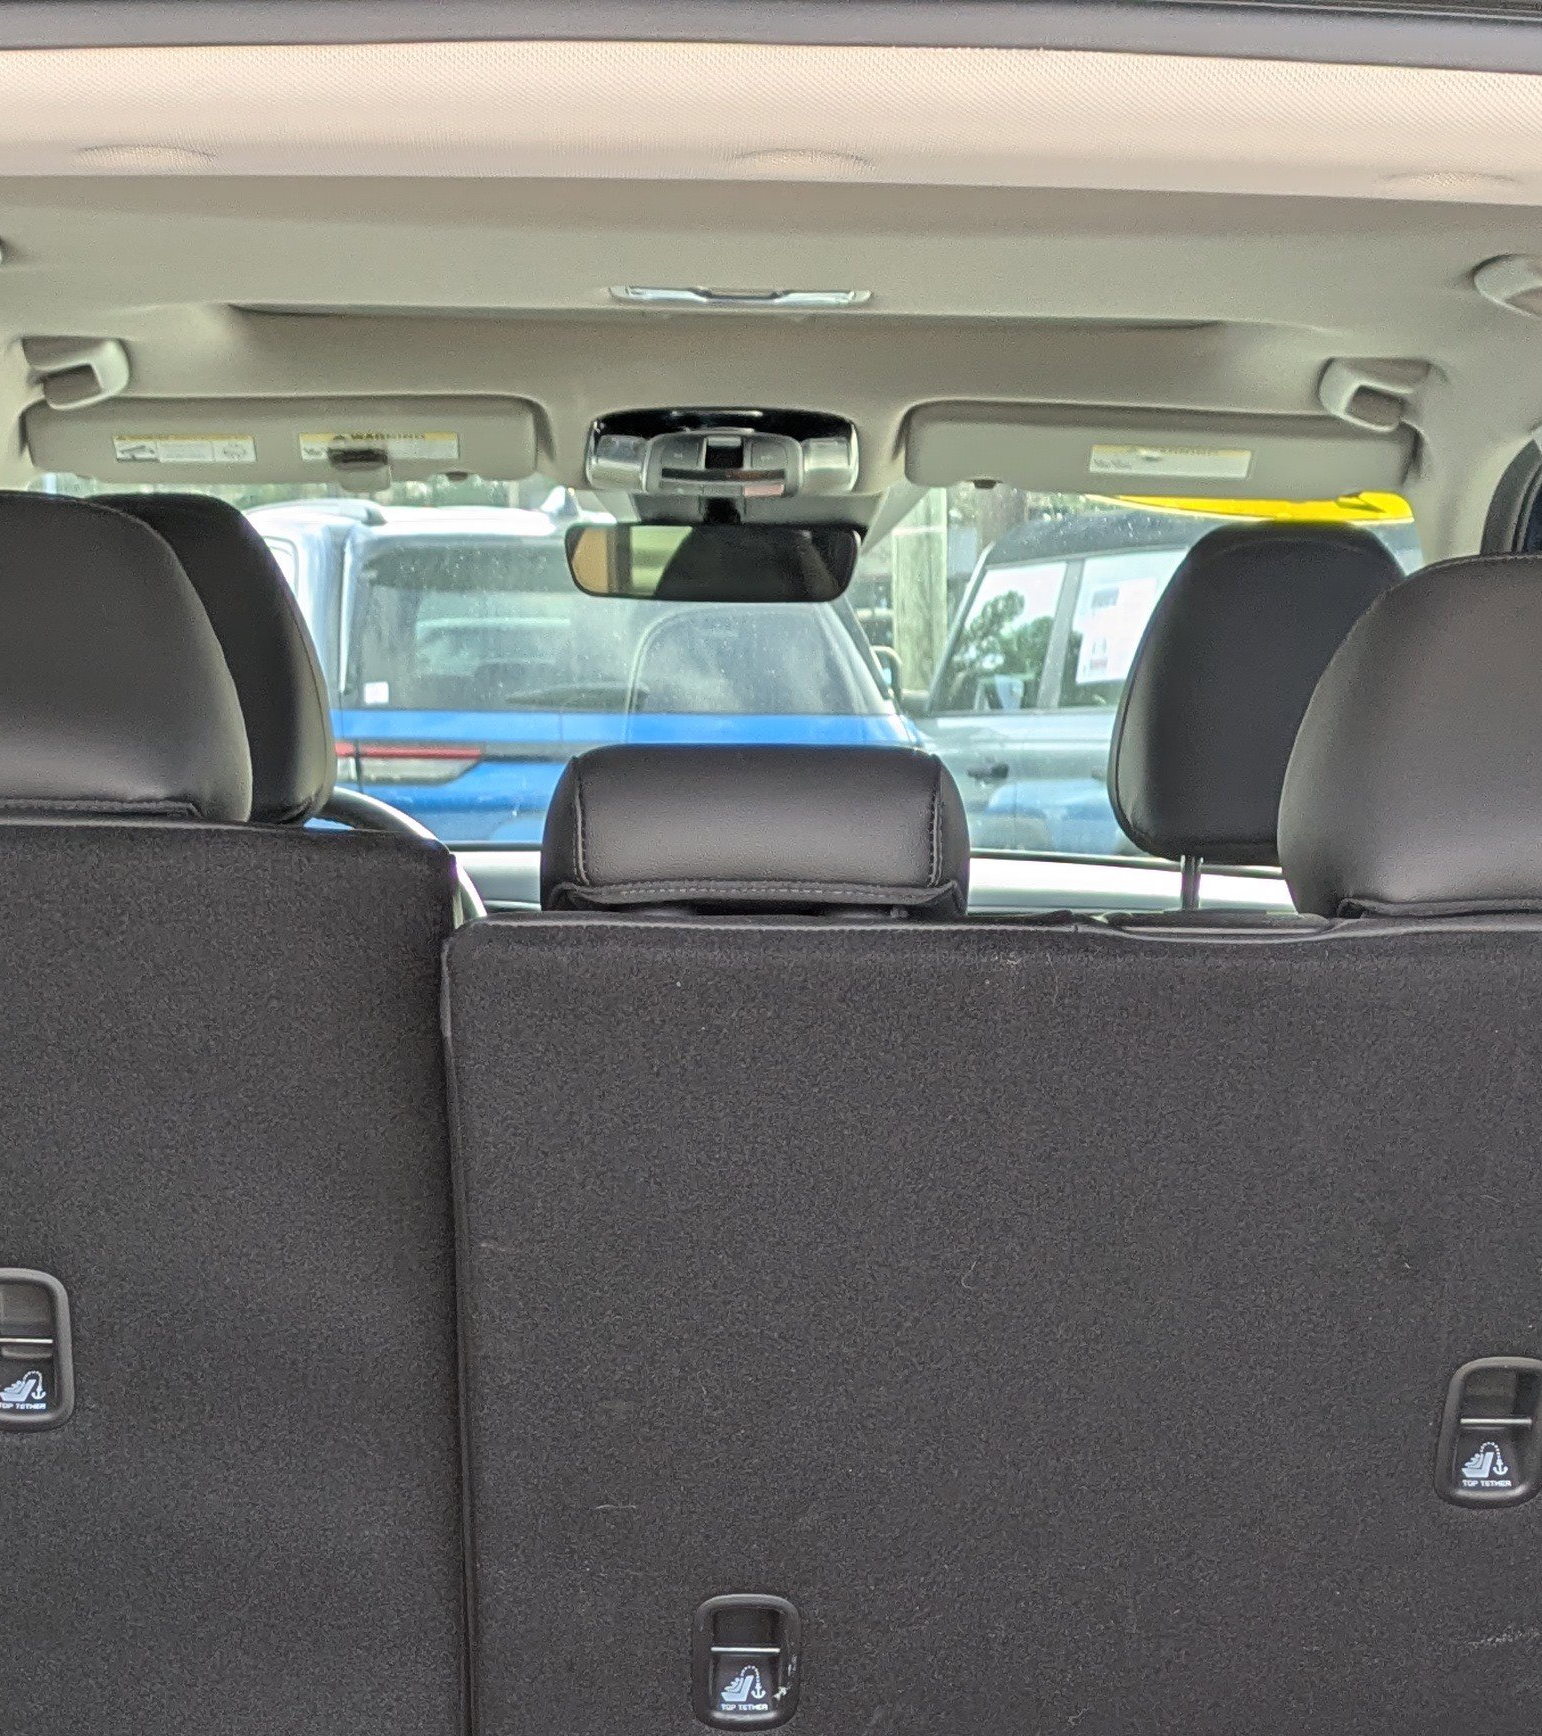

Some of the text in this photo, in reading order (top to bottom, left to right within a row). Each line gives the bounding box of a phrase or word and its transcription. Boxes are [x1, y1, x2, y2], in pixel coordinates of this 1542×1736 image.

[15, 1402, 47, 1410] TETHER
[1462, 1479, 1512, 1487] TOP TETHER
[720, 1703, 769, 1711] TOP TETHER
